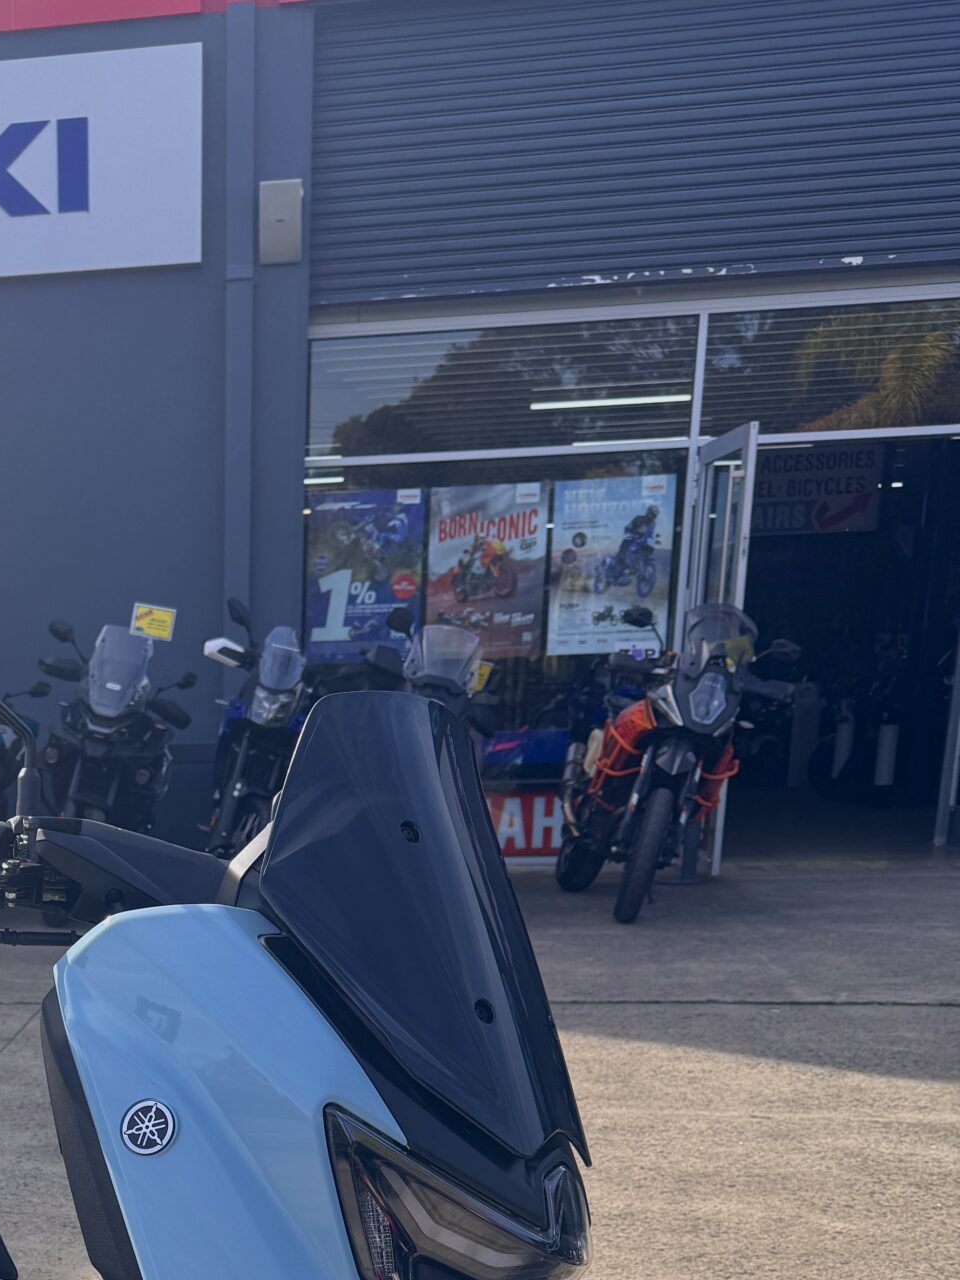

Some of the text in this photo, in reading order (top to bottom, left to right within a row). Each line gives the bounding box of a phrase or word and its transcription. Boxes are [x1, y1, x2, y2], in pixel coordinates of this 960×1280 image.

[762, 449, 876, 474] ACCESSORIES
[787, 476, 866, 498] BICYCLES
[438, 511, 479, 543] BORN
